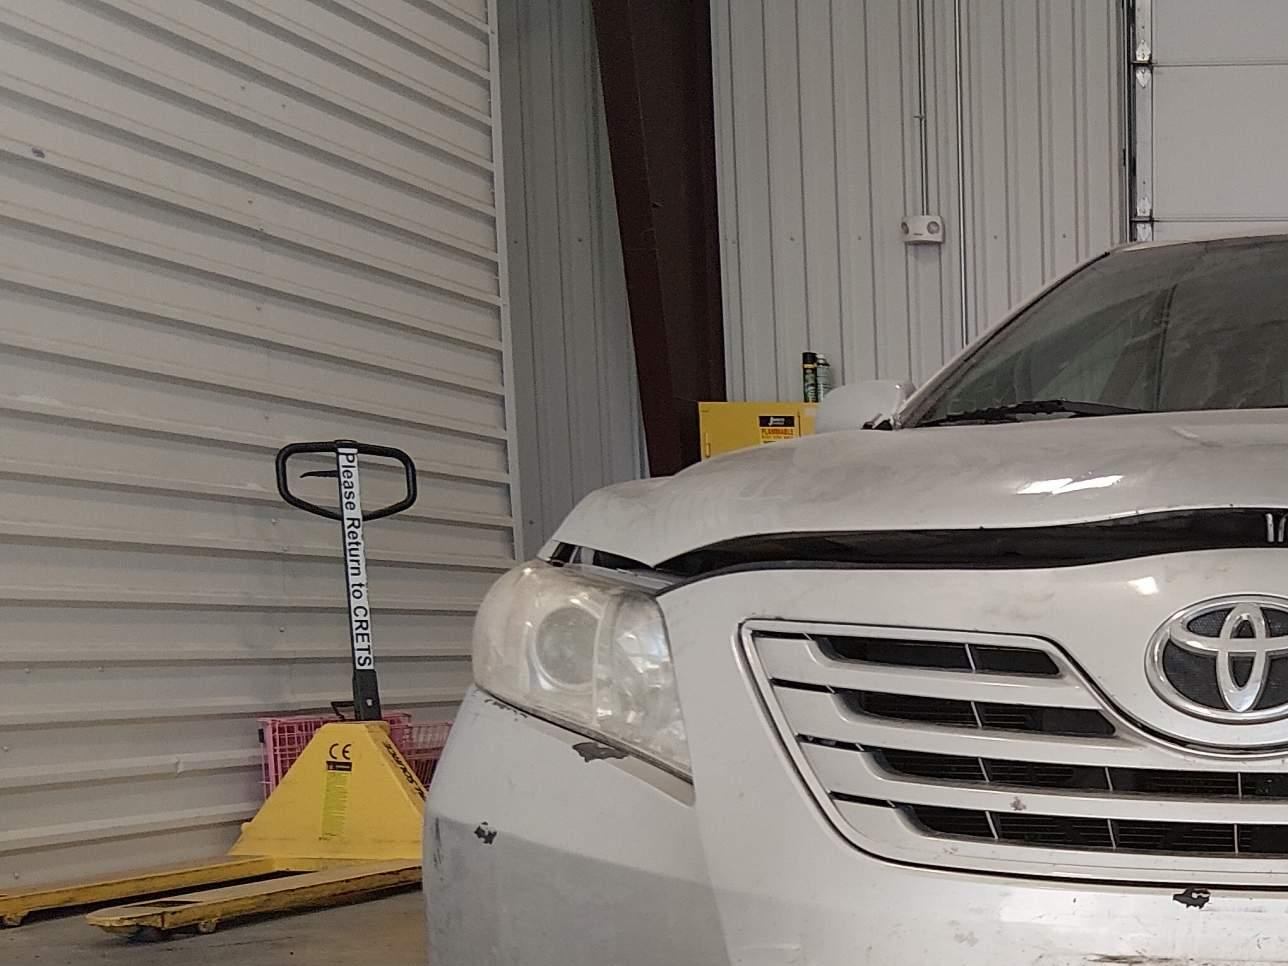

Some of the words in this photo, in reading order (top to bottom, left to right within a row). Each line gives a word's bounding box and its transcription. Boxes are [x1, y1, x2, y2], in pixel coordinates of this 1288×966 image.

[341, 453, 357, 511] Please
[346, 517, 362, 576] Return
[351, 583, 365, 600] to
[353, 606, 372, 667] CRETS
